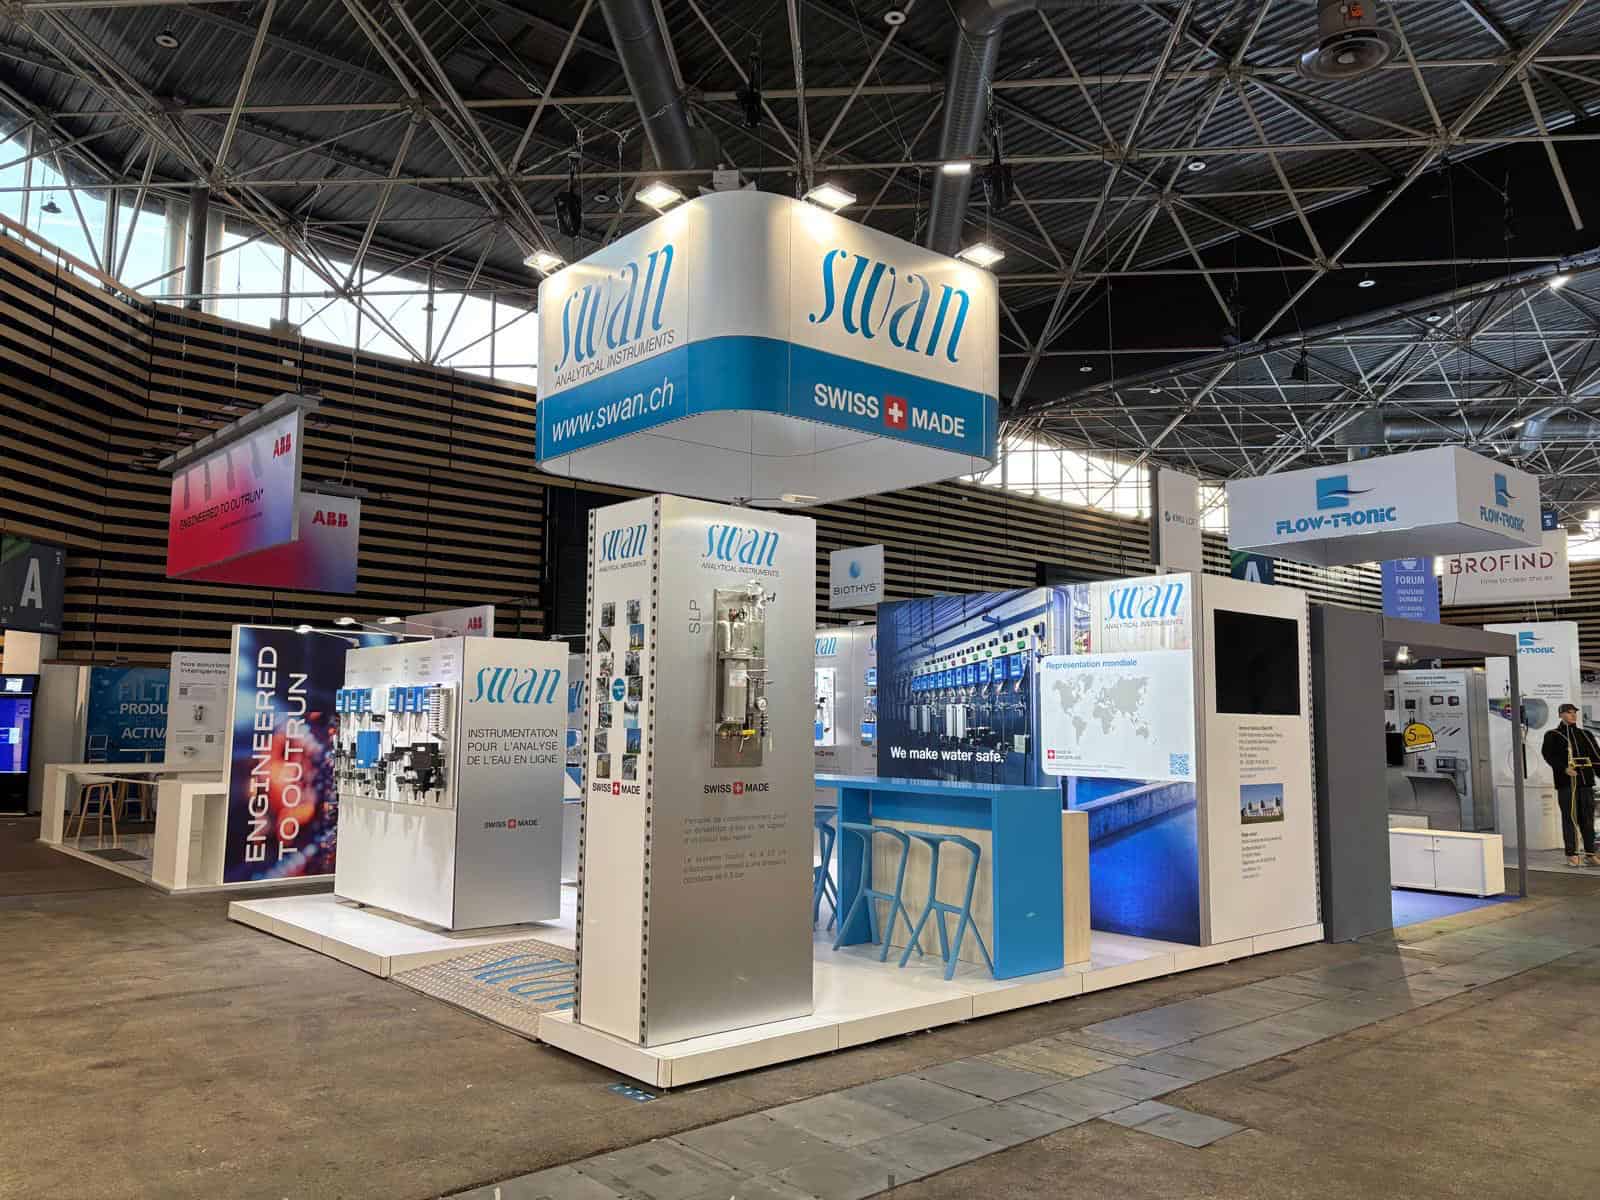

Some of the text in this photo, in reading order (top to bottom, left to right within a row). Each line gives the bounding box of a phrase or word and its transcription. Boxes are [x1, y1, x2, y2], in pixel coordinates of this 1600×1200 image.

[554, 244, 674, 371] swan
[809, 248, 970, 363] swan
[555, 329, 675, 388] ANALYTICAL INSTRUMENTS
[552, 376, 674, 442] www.swan.ch
[813, 383, 966, 438] SWISS MADE
[273, 432, 291, 459] ABB
[179, 506, 220, 530] ENGINEERED
[312, 510, 348, 528] ABB
[599, 523, 648, 562] swan
[702, 524, 780, 567] swan
[701, 562, 779, 578] ANALYTICAL INSTRUMENTS
[1450, 552, 1554, 575] BROFIND
[20, 558, 43, 609] A
[833, 583, 876, 596] BIOTHYS
[1395, 575, 1425, 585] FORUM
[1105, 583, 1184, 621] swan
[467, 616, 482, 631] ABB
[689, 599, 704, 634] SLP
[469, 666, 561, 704] swan
[468, 728, 558, 738] INSTRUMENTATION
[246, 646, 278, 863] ENGINEERED
[467, 741, 558, 752] POUR L'ANALYSE
[890, 746, 1005, 763] We make water safe.
[277, 672, 309, 862] TO OUTRUN
[466, 754, 558, 766] DE L'EAU EN LIGNE
[592, 782, 641, 795] SWISS MADE
[704, 782, 769, 794] SWISS MADE
[484, 819, 539, 829] SWISS MADE
